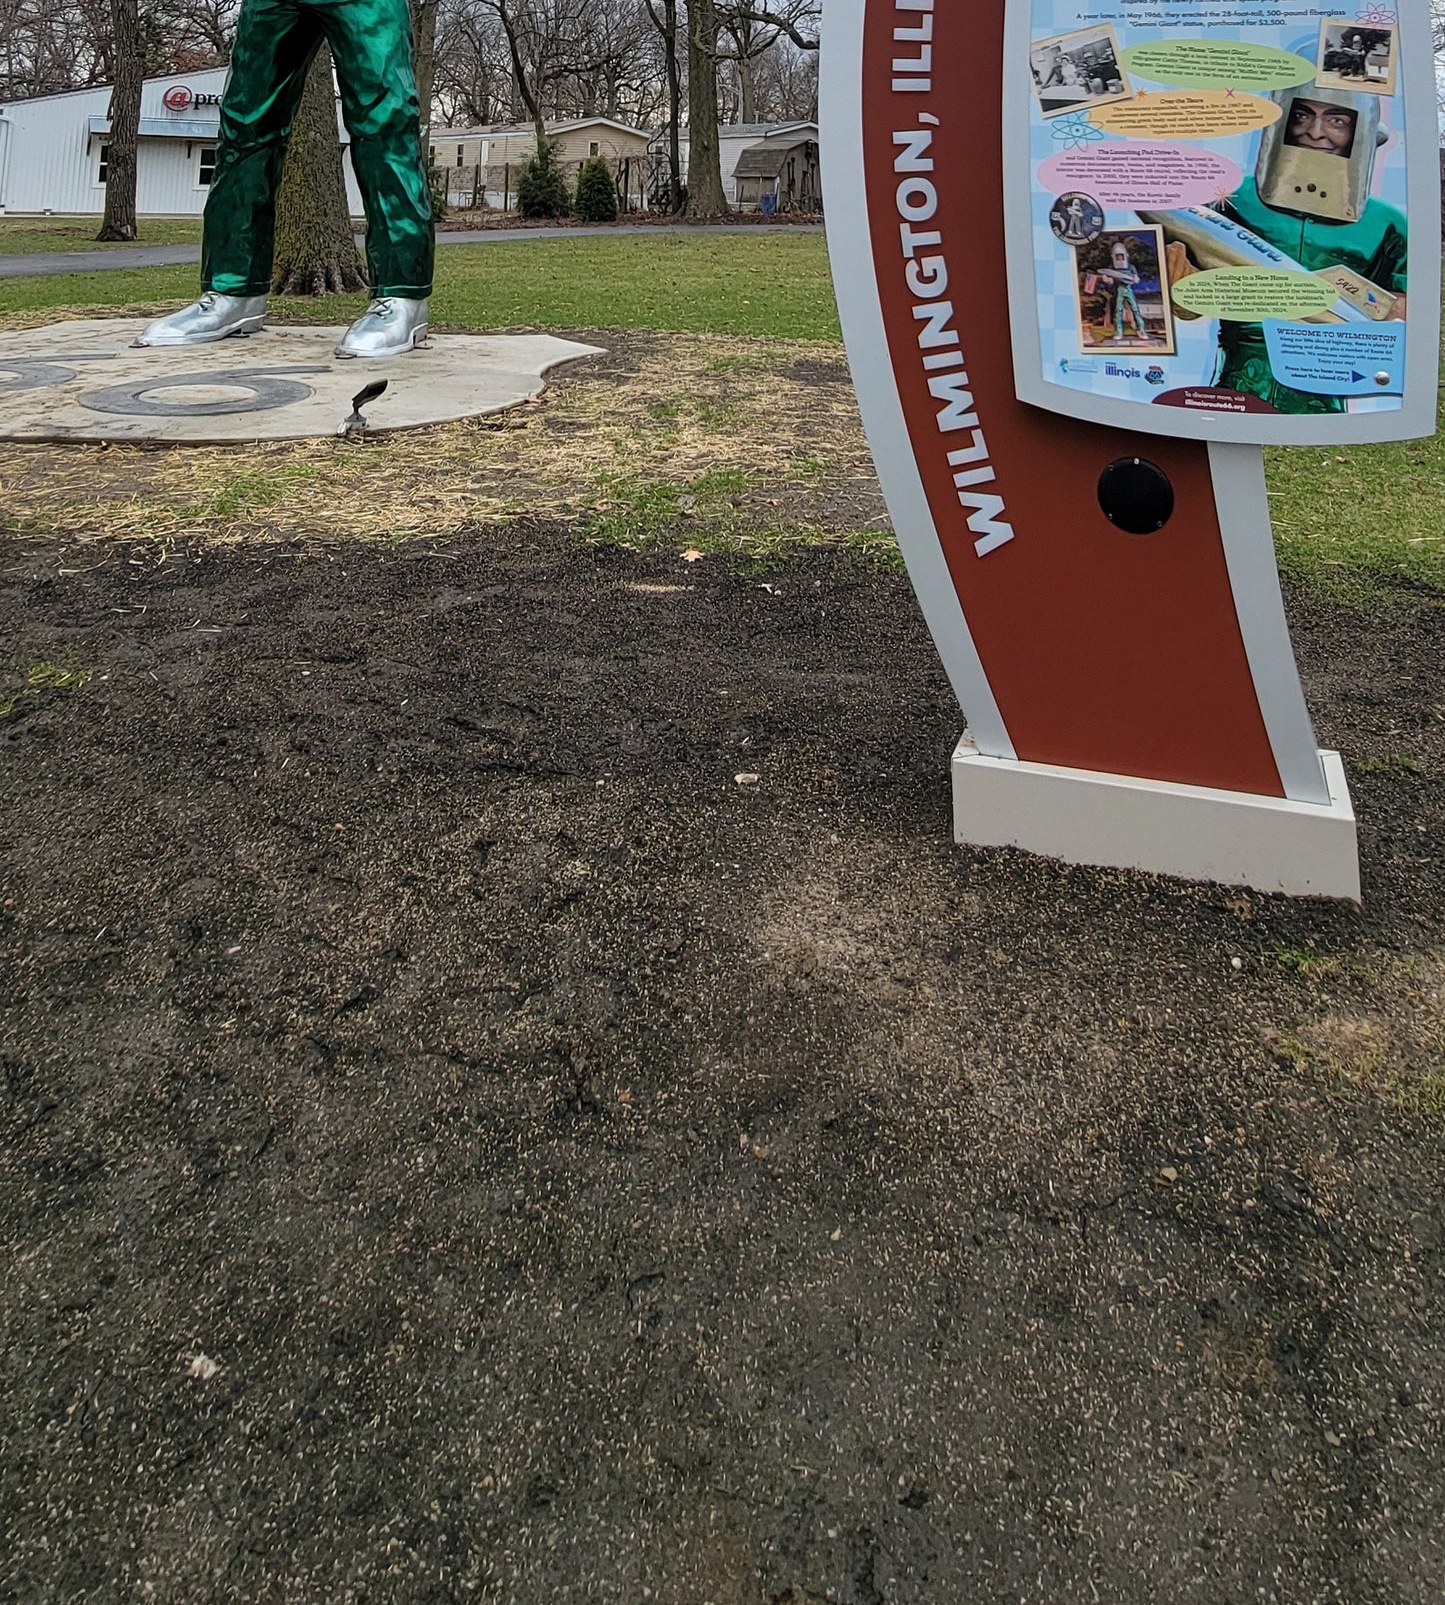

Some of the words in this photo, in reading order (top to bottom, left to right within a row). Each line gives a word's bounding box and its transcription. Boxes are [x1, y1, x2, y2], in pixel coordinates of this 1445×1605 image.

[1336, 278, 1360, 295] 5422
[893, 112, 1016, 559] WILMINGTON,
[1277, 328, 1321, 336] WELCOME
[1337, 332, 1396, 341] WILMINGTON
[1105, 365, 1140, 378] illinois
[1185, 399, 1245, 411] illinoisroute66.org
